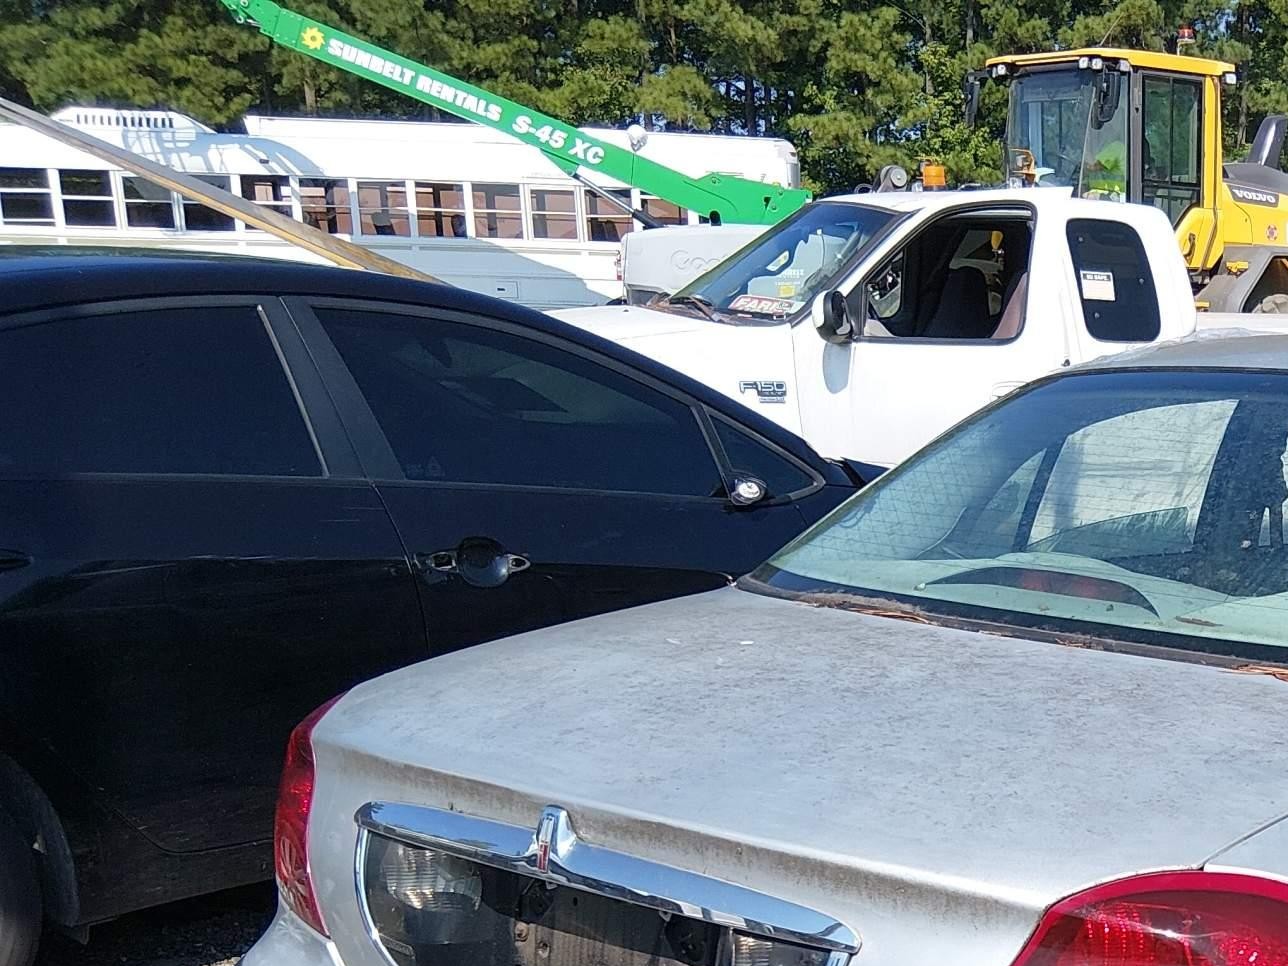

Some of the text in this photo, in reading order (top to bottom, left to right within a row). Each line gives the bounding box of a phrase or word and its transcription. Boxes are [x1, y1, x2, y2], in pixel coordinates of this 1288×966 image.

[327, 38, 502, 122] SUNBELT RENTALS
[512, 115, 605, 164] S-45 XC
[1231, 189, 1276, 203] VOLVO
